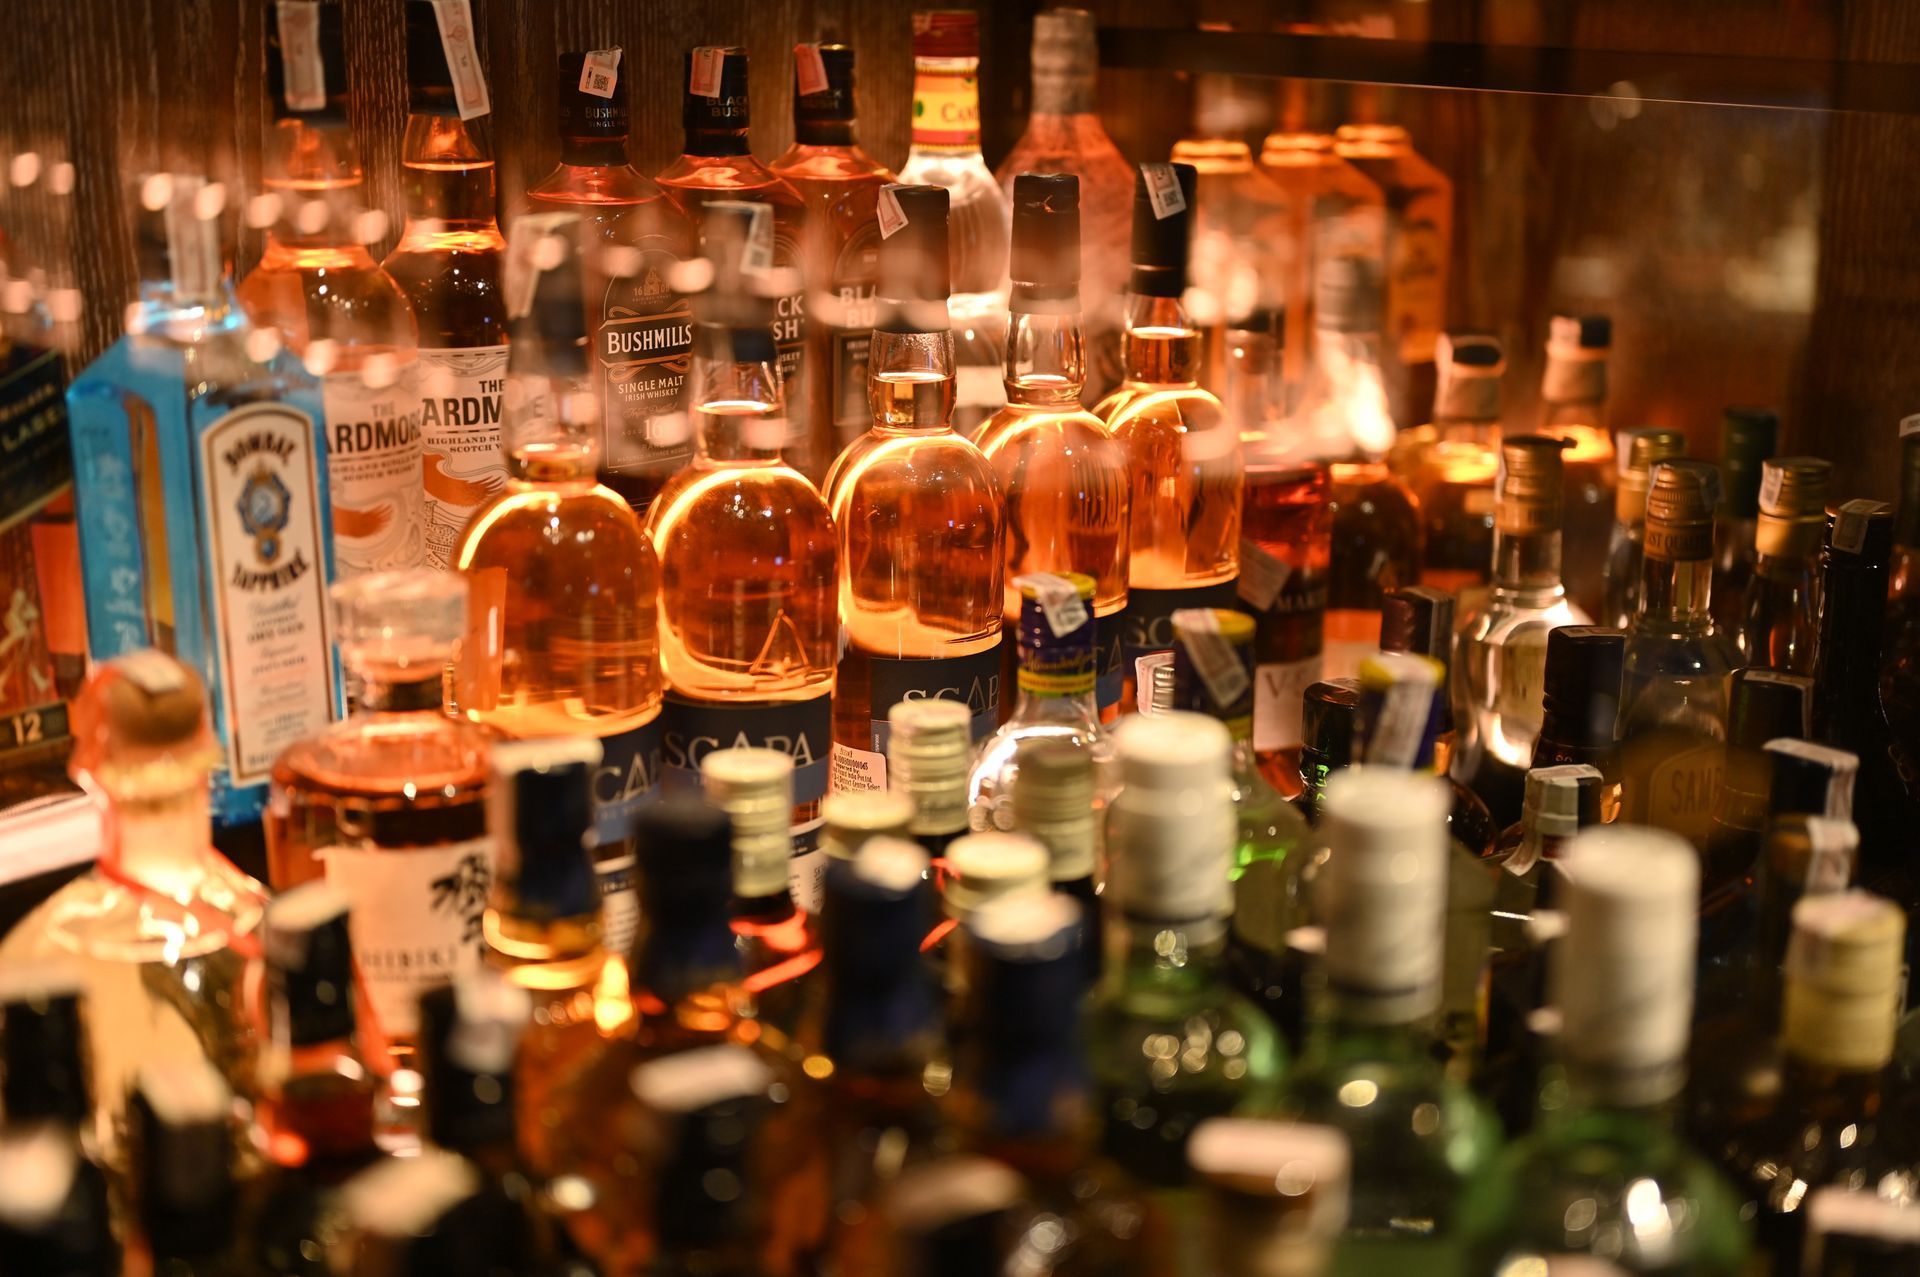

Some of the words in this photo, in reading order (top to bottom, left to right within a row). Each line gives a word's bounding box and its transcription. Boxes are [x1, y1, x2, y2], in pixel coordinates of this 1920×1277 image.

[607, 323, 692, 354] BUSHMILLS
[479, 379, 504, 393] THE
[618, 379, 656, 394] SINGLE
[658, 375, 684, 389] MALT
[625, 393, 645, 402] IRISH
[646, 388, 679, 399] WHISKEY
[427, 436, 486, 445] HIGHLAND
[449, 445, 492, 453] SCOTCH
[13, 711, 43, 745] 12
